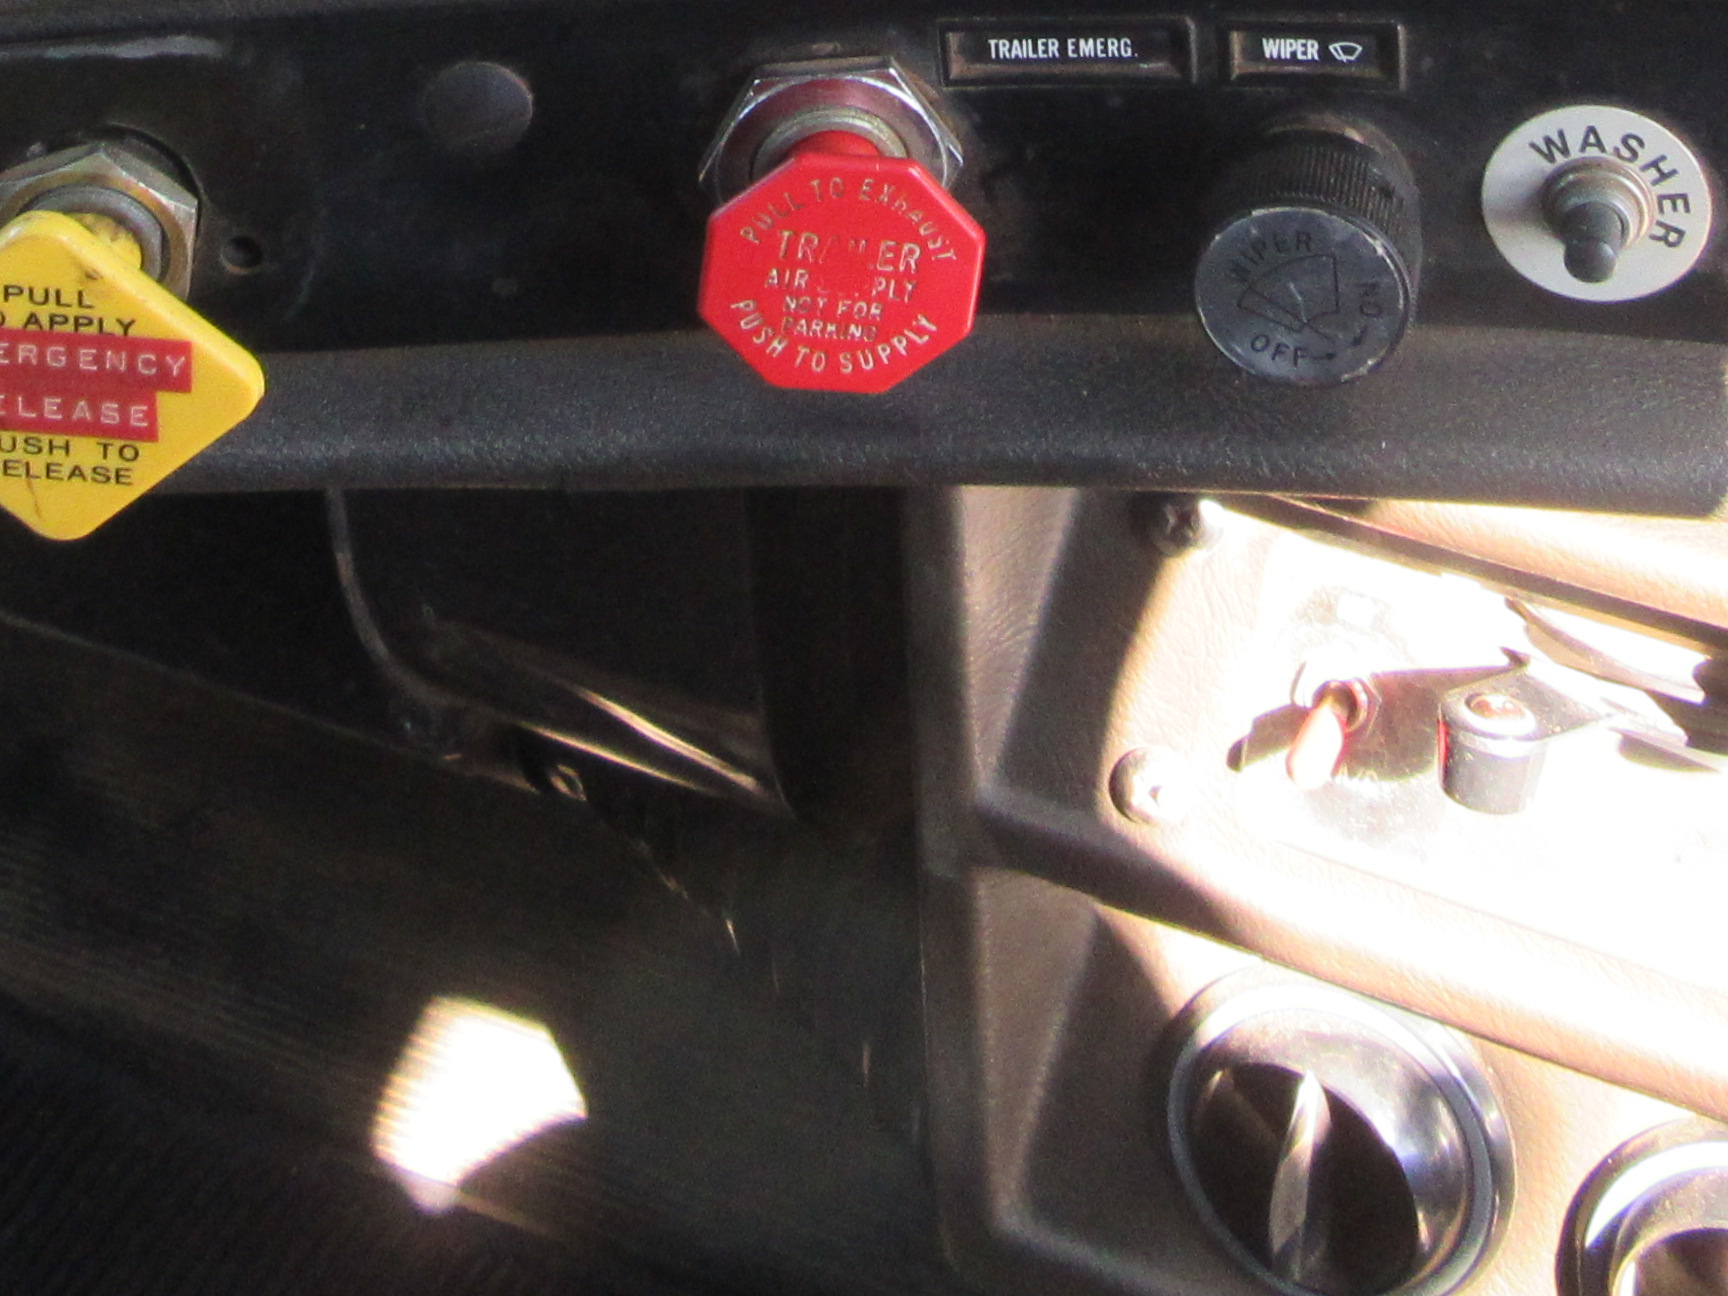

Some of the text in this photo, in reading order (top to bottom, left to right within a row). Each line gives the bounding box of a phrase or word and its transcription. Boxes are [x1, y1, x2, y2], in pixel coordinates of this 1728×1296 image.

[988, 38, 1138, 59] TRAILER EMERG.
[1262, 38, 1319, 61] WIPER
[1528, 125, 1692, 251] WASHER
[739, 177, 957, 263] PULL TO EXHAUST
[778, 230, 922, 273] TRER
[1229, 230, 1312, 282] WIPER
[765, 268, 809, 289] AIR
[2, 284, 95, 309] PULL
[783, 295, 884, 321] NOT FOR
[24, 312, 136, 337] APPLY
[730, 299, 938, 374] PUSH TO SUPPLY
[781, 317, 879, 342] PARKING
[1250, 334, 1306, 368] OFF
[96, 442, 140, 462] TO
